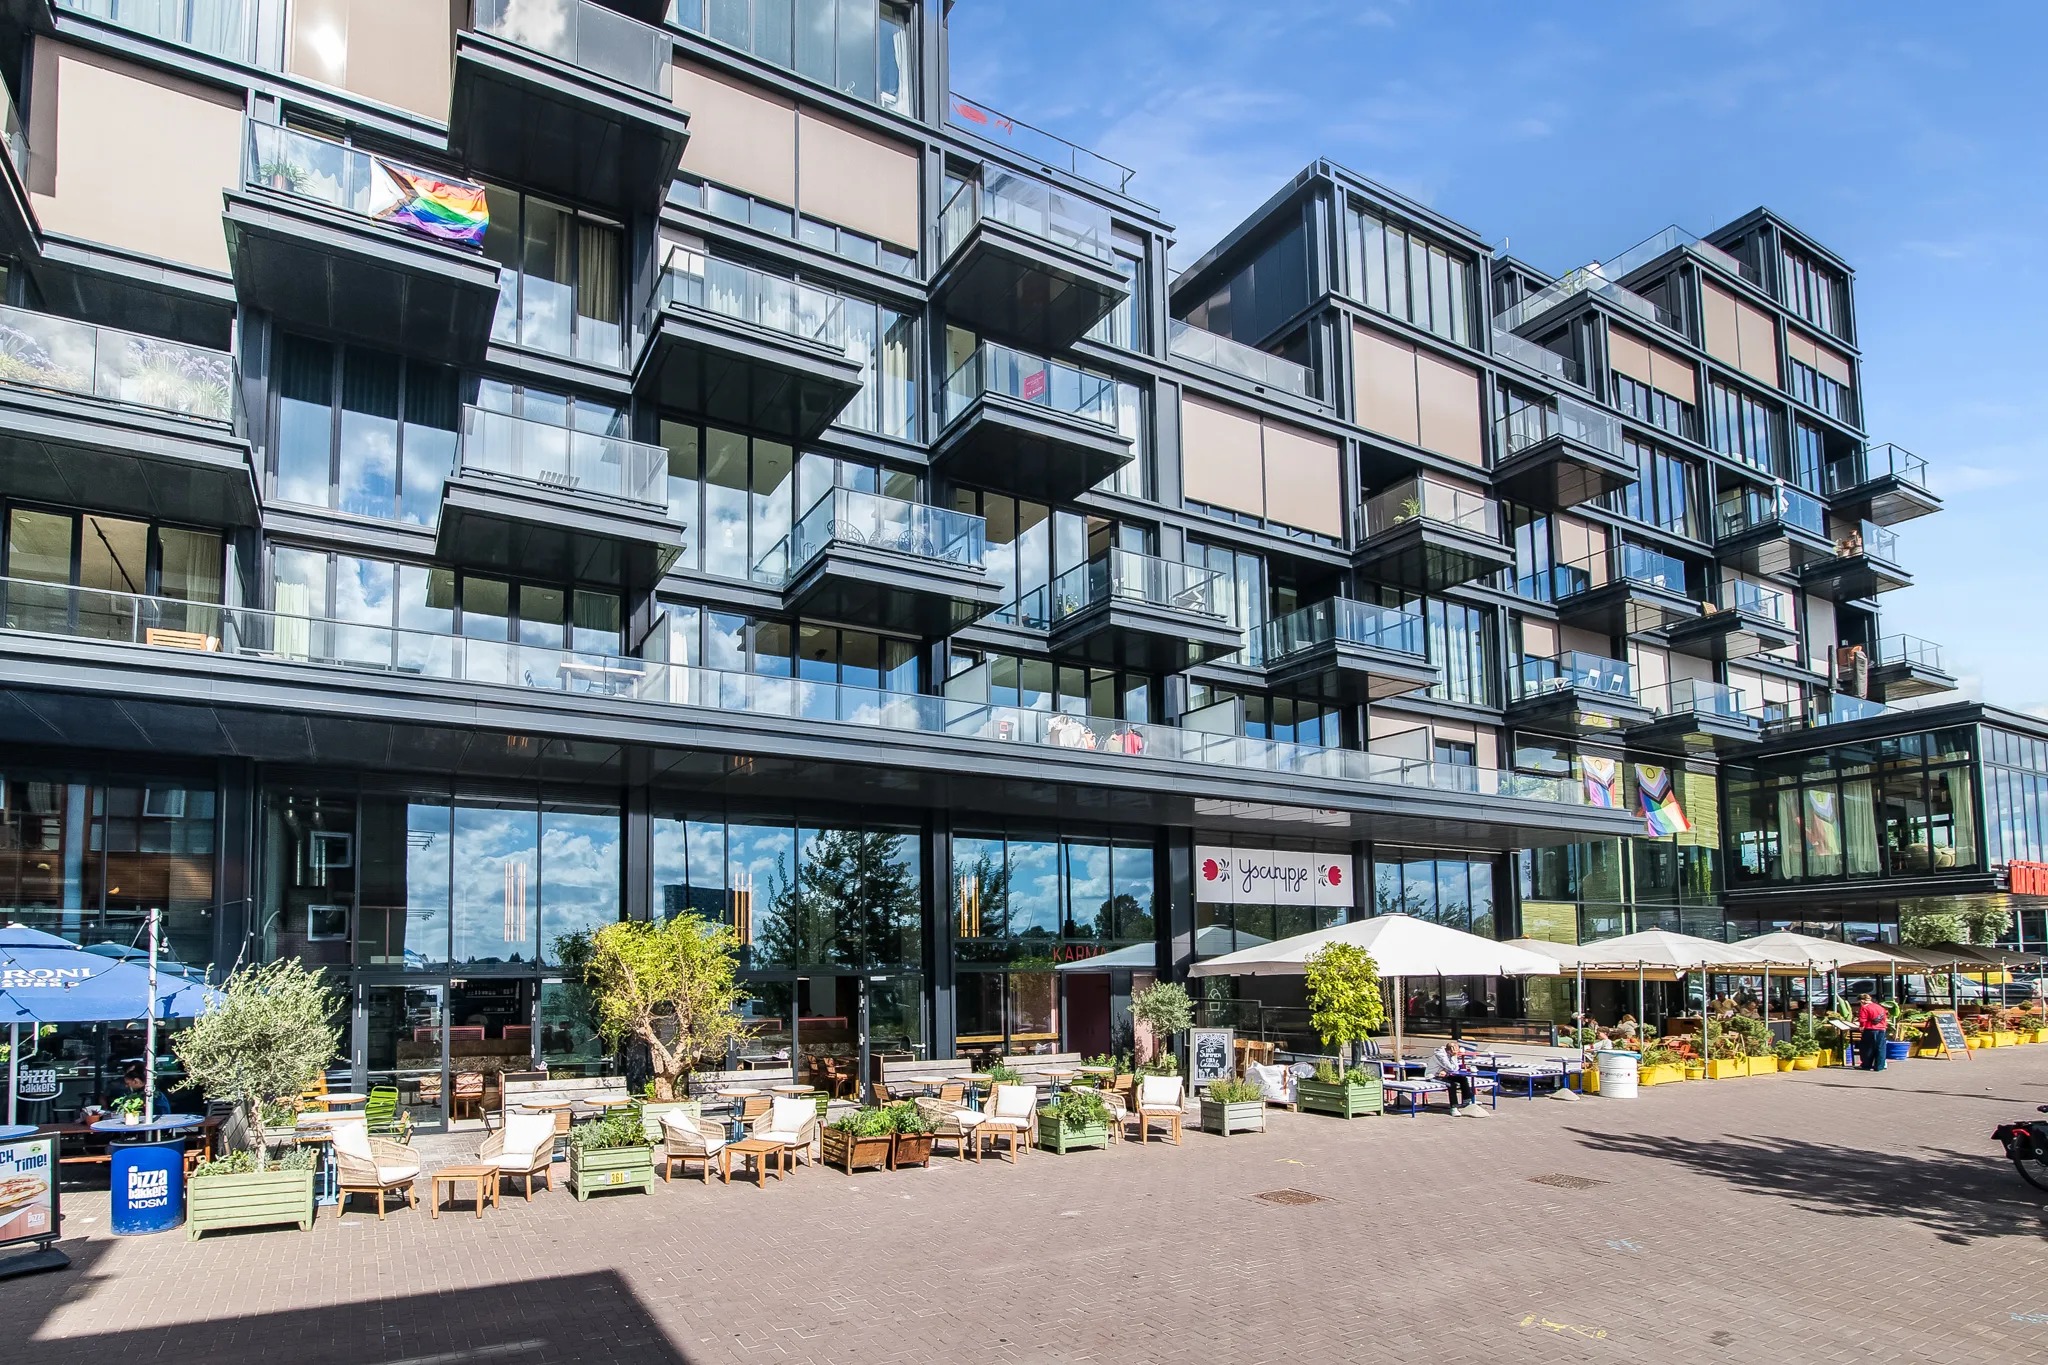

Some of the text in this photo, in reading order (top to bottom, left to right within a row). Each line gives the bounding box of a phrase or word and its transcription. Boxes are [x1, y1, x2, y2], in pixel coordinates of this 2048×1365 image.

[0, 968, 96, 979] RONI
[611, 1172, 623, 1183] 361
[128, 1196, 168, 1210] NDSM
